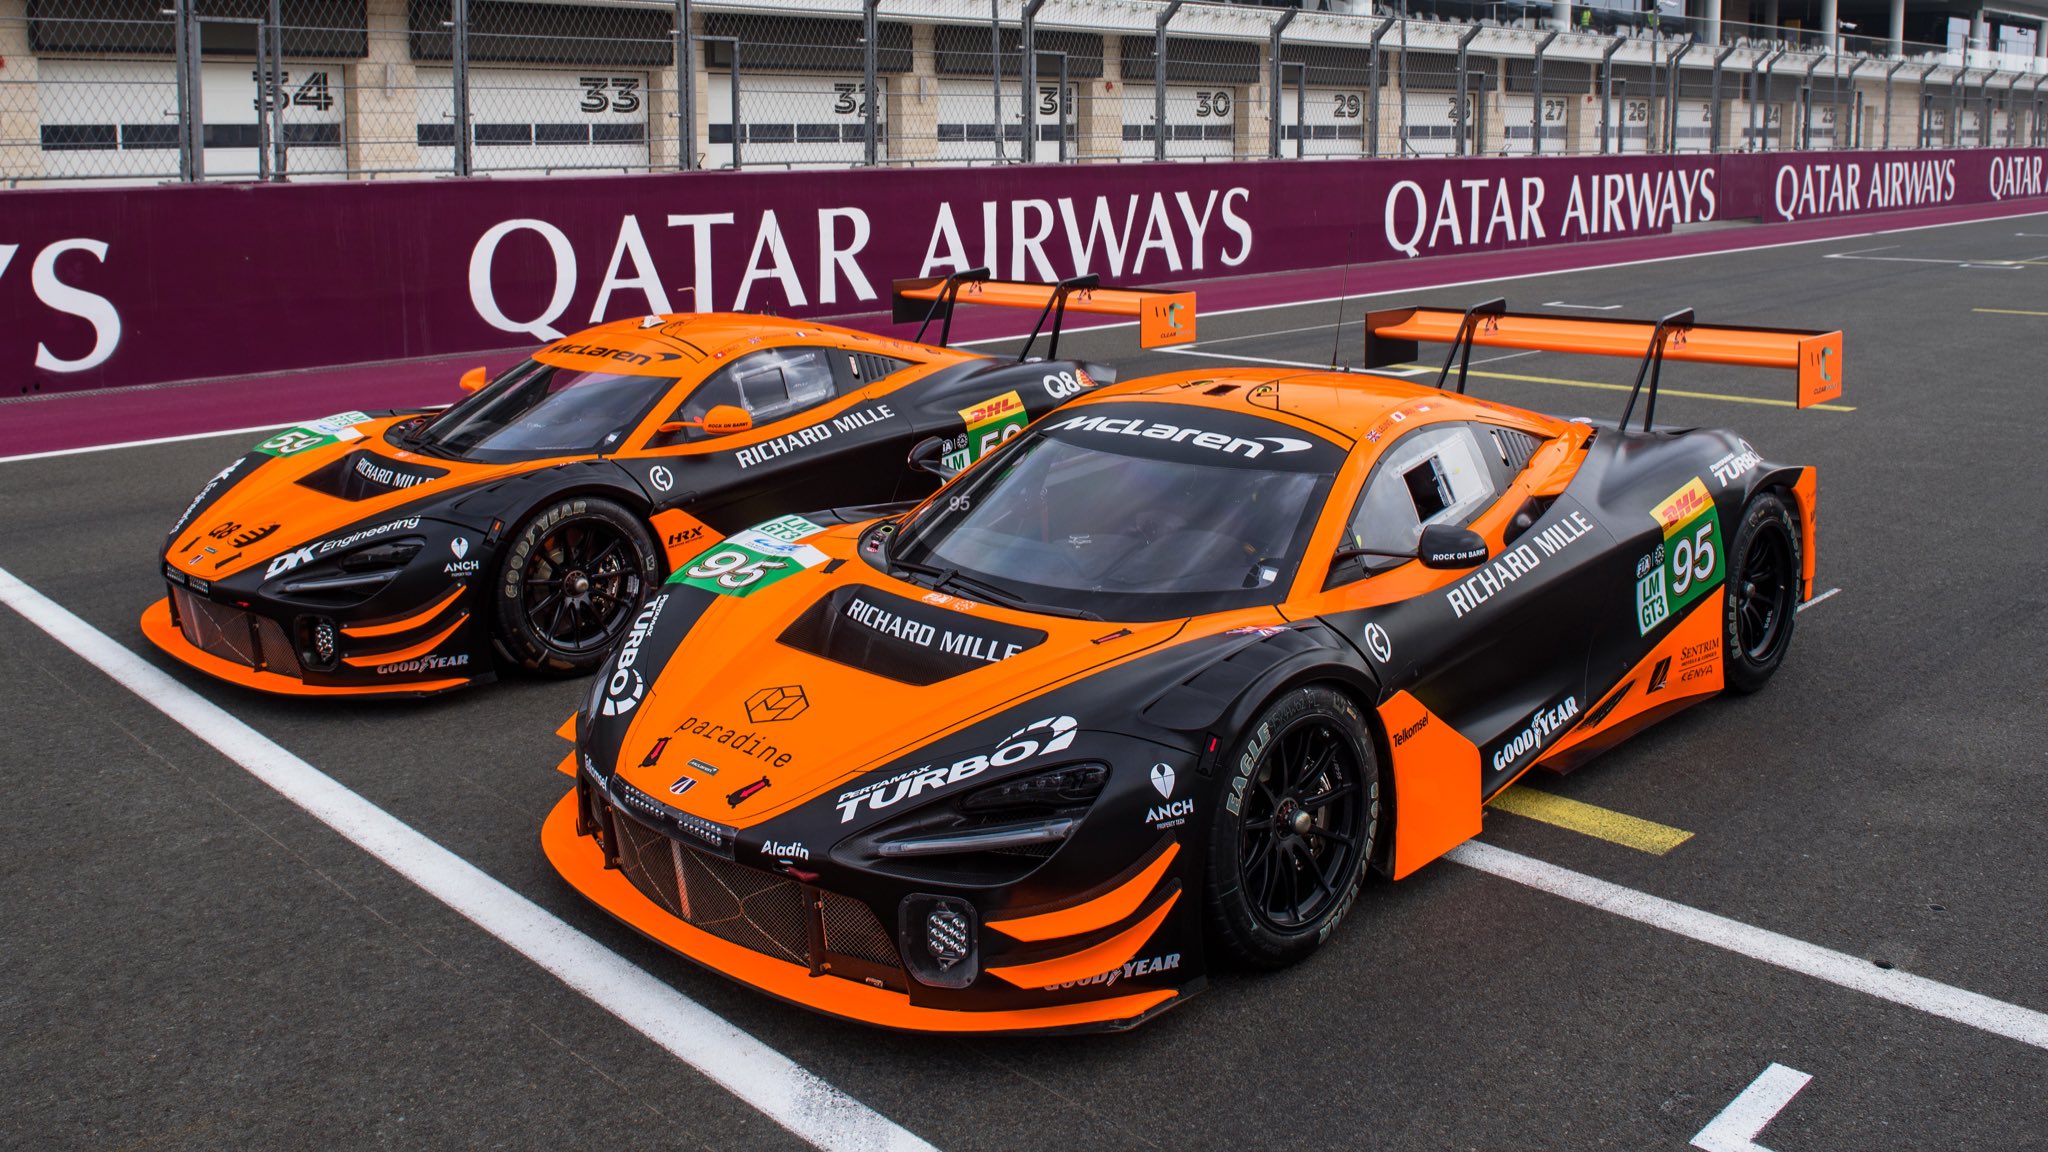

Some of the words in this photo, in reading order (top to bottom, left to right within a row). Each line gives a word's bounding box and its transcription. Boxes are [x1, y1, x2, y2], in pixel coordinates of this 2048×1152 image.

[580, 77, 640, 113] 33
[1196, 91, 1230, 117] 30
[1333, 94, 1360, 118] 29
[1545, 100, 1565, 121] 27
[1628, 102, 1646, 121] 26
[1775, 163, 1861, 222] QATAR
[1867, 158, 1956, 209] AIRWAYS
[1989, 156, 2042, 200] QATAR
[1384, 176, 1546, 257] QATAR
[1560, 168, 1715, 234] AIRWAYS
[469, 207, 878, 342] QATAR
[919, 187, 1253, 283] AIRWAYS
[549, 344, 652, 366] McLaren
[1042, 371, 1080, 399] Q8
[969, 398, 1015, 422] DHL
[262, 431, 324, 454] 59
[735, 424, 833, 469] RICHARD
[833, 403, 896, 434] MILLE
[1042, 414, 1265, 459] McLaren
[355, 457, 393, 485] RICHARD
[1713, 450, 1762, 488] TURBO
[947, 495, 972, 511] 95
[1662, 488, 1704, 524] DHL
[208, 521, 242, 540] Q8
[668, 525, 704, 545] HRX
[760, 523, 802, 542] GT3
[782, 516, 815, 533] LM
[264, 541, 324, 581] DK
[319, 514, 422, 553] Engineering
[1432, 552, 1455, 561] ROCK
[1456, 552, 1468, 560] ON
[1671, 522, 1715, 596] 95
[444, 560, 480, 573] ANCH
[685, 550, 789, 590] 95
[1445, 544, 1541, 619] RICHARD
[1537, 510, 1594, 559] MILLE
[1642, 578, 1660, 602] LM
[1641, 597, 1665, 628] GT3
[846, 597, 935, 645] RICHARD
[938, 628, 1023, 662] MILLE
[609, 595, 660, 696] TURBO
[1680, 637, 1719, 661] SENTRIM
[376, 653, 470, 674] GOODYEAR
[1680, 664, 1713, 682] KENYA
[673, 716, 793, 768] paradine
[1392, 711, 1430, 748] Telkomsel
[1493, 695, 1579, 772] GOODYEAR
[835, 740, 1039, 824] TURBO
[837, 764, 932, 803] PERTAMAX
[1225, 722, 1271, 817] EAGLE
[1145, 799, 1194, 823] ANCH
[760, 839, 810, 861] Aladin
[1043, 953, 1181, 992] DYEAR
